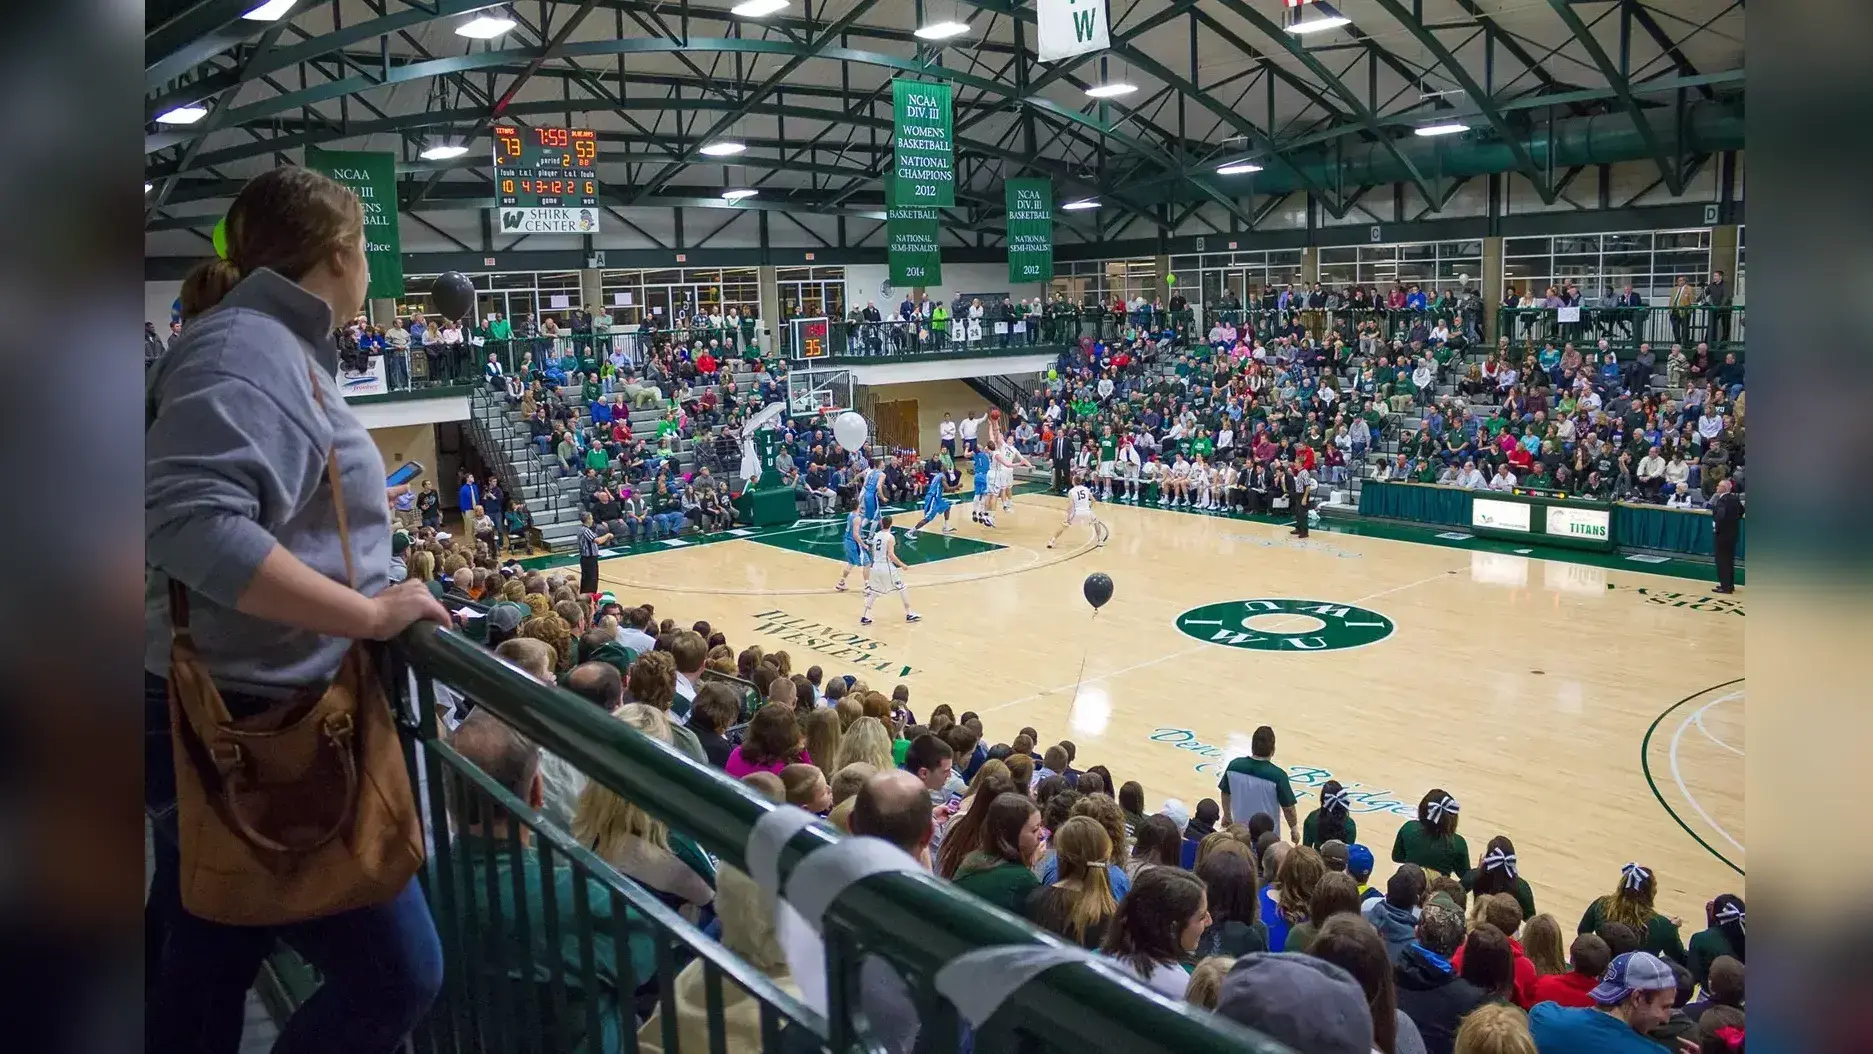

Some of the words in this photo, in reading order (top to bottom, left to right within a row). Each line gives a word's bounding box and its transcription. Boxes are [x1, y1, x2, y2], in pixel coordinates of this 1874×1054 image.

[1072, 8, 1096, 43] W
[908, 94, 937, 107] NCAA
[907, 106, 928, 118] DIV.
[929, 108, 940, 119] III
[535, 128, 568, 146] 7:59
[501, 138, 521, 155] 73
[575, 141, 595, 158] 53
[898, 138, 951, 151] BASKETBALL
[540, 157, 560, 165] period
[562, 154, 571, 167] 2
[900, 155, 949, 168] NATIONAL
[333, 169, 370, 180] NCAA
[538, 170, 558, 178] player
[898, 168, 952, 181] CHAMPIONS
[361, 187, 374, 197] III
[502, 180, 514, 193] 10
[522, 181, 530, 192] 4
[567, 181, 575, 193] 2
[585, 181, 593, 193] 6
[915, 185, 936, 196] 2012
[1018, 190, 1040, 200] NCAA
[1017, 200, 1033, 210] DIV.
[1034, 201, 1042, 210] III
[531, 209, 570, 220] SHIRK
[889, 210, 938, 219] BASKETBALL
[1009, 211, 1050, 220] BASKETBALL
[1706, 208, 1716, 220] D
[525, 220, 576, 231] CENTER
[896, 234, 932, 242] NATIONAL
[1015, 235, 1046, 243] NATIONAL
[1372, 227, 1380, 239] C
[364, 242, 391, 252] Place
[891, 244, 938, 252] SEMI-FINALIST
[596, 254, 604, 264] A
[906, 267, 925, 276] 2014
[1023, 265, 1040, 274] 2012
[805, 339, 821, 356] 35
[1076, 489, 1086, 501] 15
[1569, 522, 1606, 537] TITANS
[876, 538, 883, 550] 2
[752, 609, 888, 650] ILLINOIS
[753, 622, 923, 677] WESLEYAN
